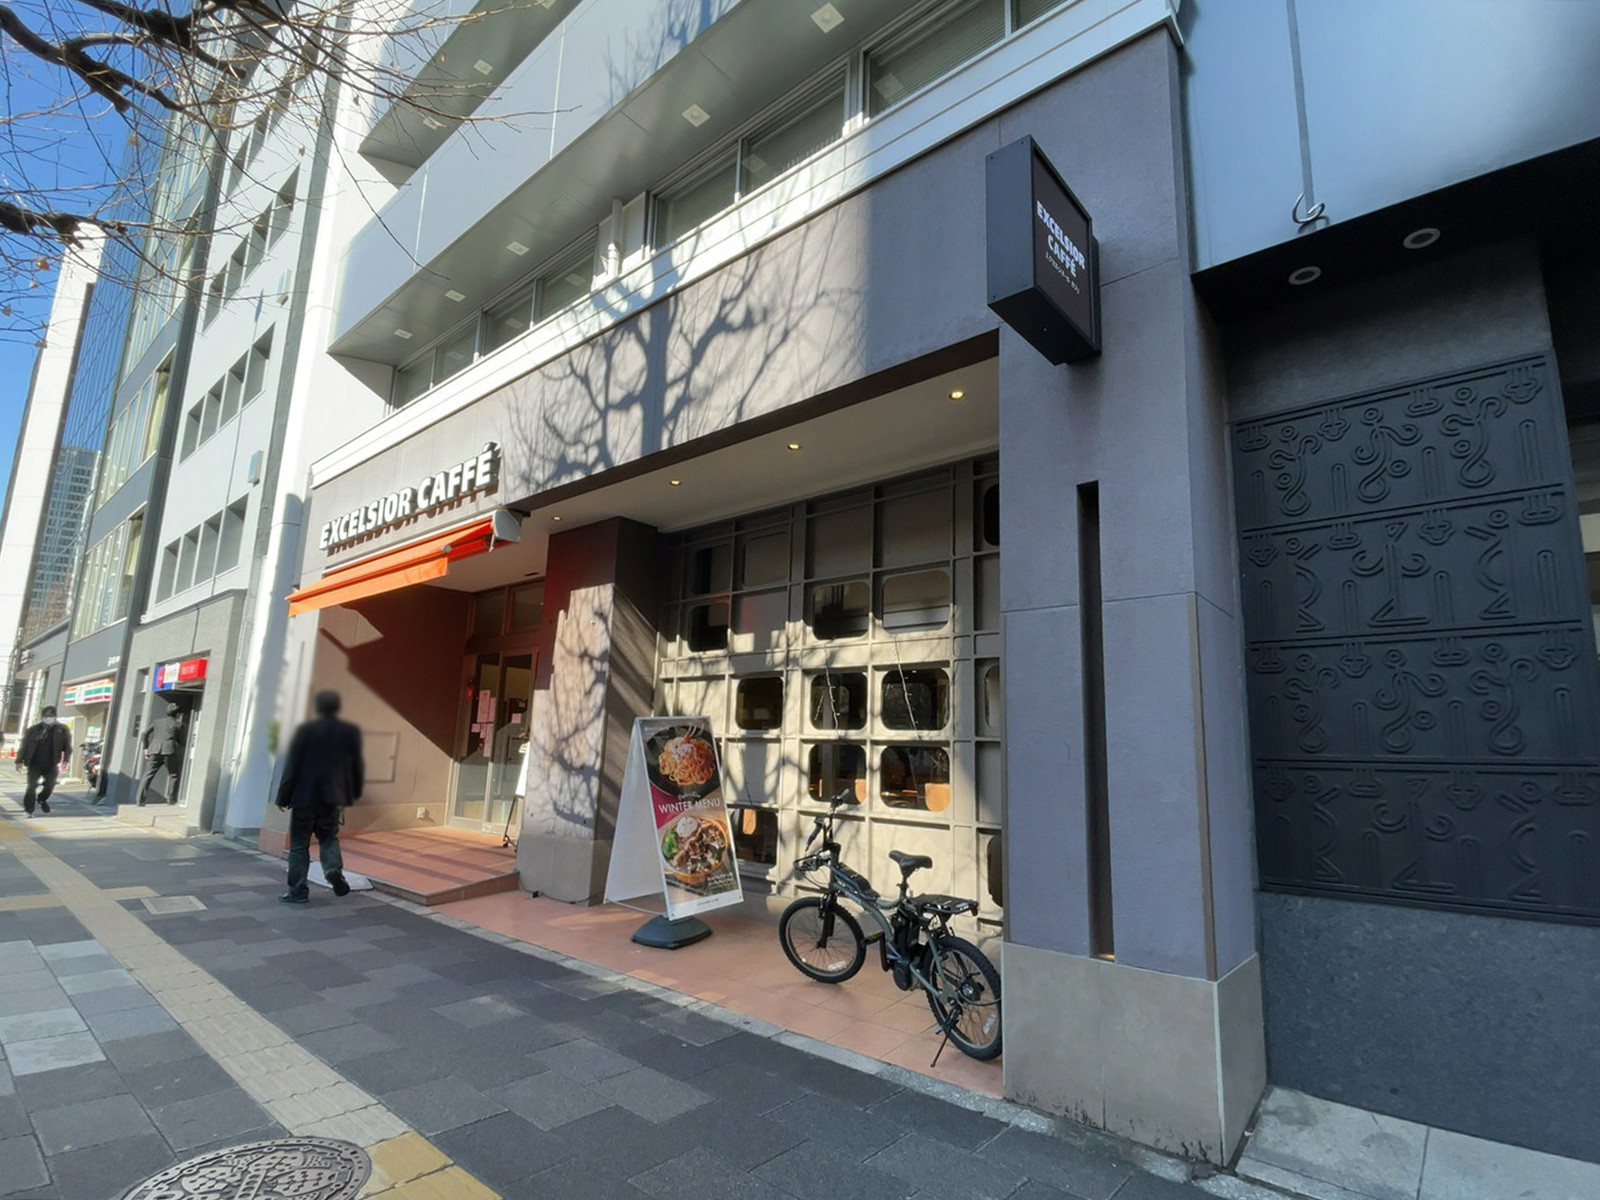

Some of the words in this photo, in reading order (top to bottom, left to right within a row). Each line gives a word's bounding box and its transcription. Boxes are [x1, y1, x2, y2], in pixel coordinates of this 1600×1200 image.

[1036, 200, 1085, 270] EXCELSIOR
[1047, 233, 1077, 278] CAFFÉ
[319, 486, 415, 550] EXCELSIOR
[417, 441, 498, 509] CAFFÉ
[695, 797, 720, 809] MENU
